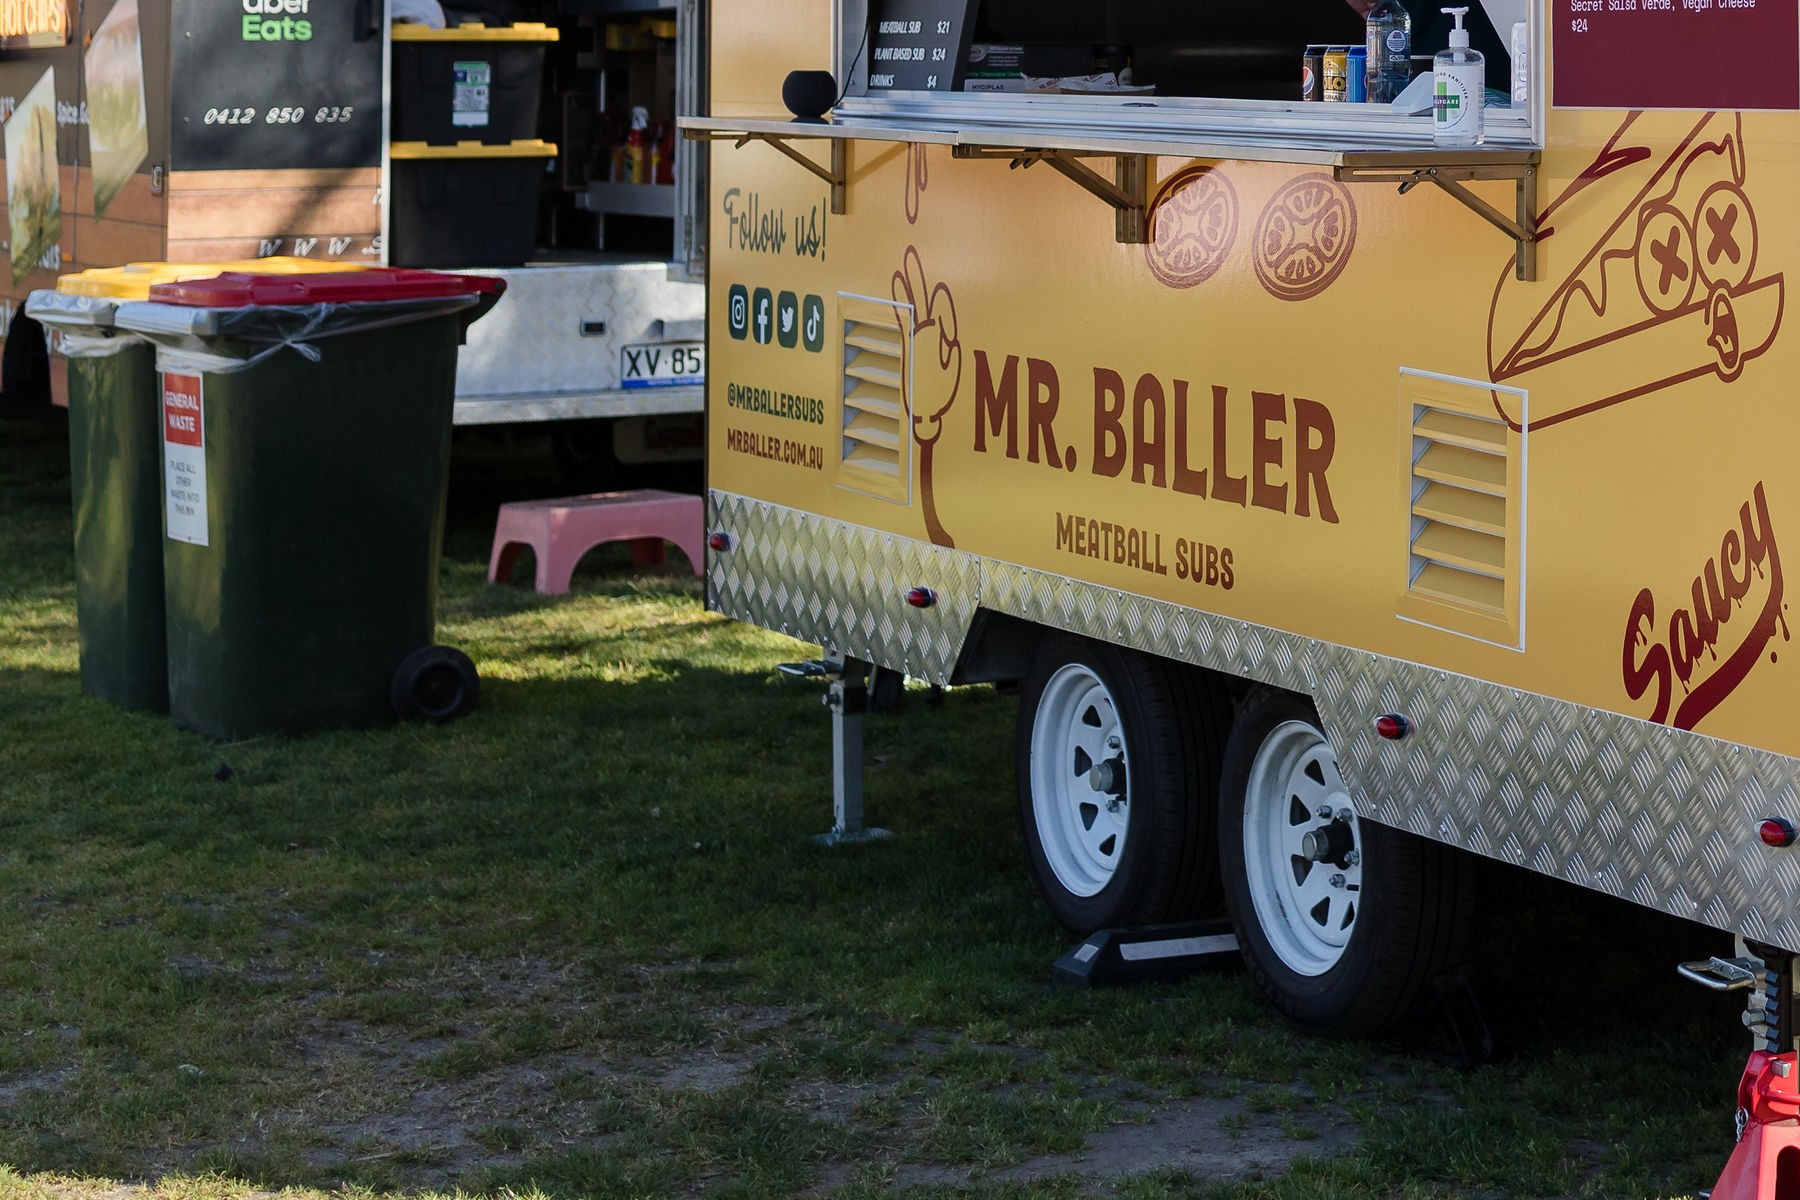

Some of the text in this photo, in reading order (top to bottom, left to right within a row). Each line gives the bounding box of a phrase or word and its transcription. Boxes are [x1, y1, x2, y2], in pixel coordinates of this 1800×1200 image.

[242, 15, 313, 41] Eats
[879, 21, 951, 34] MEATBALL SUB $21
[1571, 19, 1588, 32] $24
[874, 48, 893, 60] PLANT
[912, 48, 925, 60] SUB
[932, 48, 946, 61] $24
[869, 74, 937, 88] DRINKS $4
[204, 108, 255, 125] 0412
[266, 107, 304, 124] 850
[723, 187, 826, 261] Follow us!
[165, 391, 199, 410] GENERAL
[727, 382, 824, 425] @MRBALLERSUBS
[168, 413, 196, 432] WASTE
[973, 349, 1340, 524] MR. BALLER
[727, 428, 823, 470] MRBALLER.COM.AU
[1055, 511, 1235, 590] MEATBALL SUBS
[1622, 480, 1791, 731] Saucy
